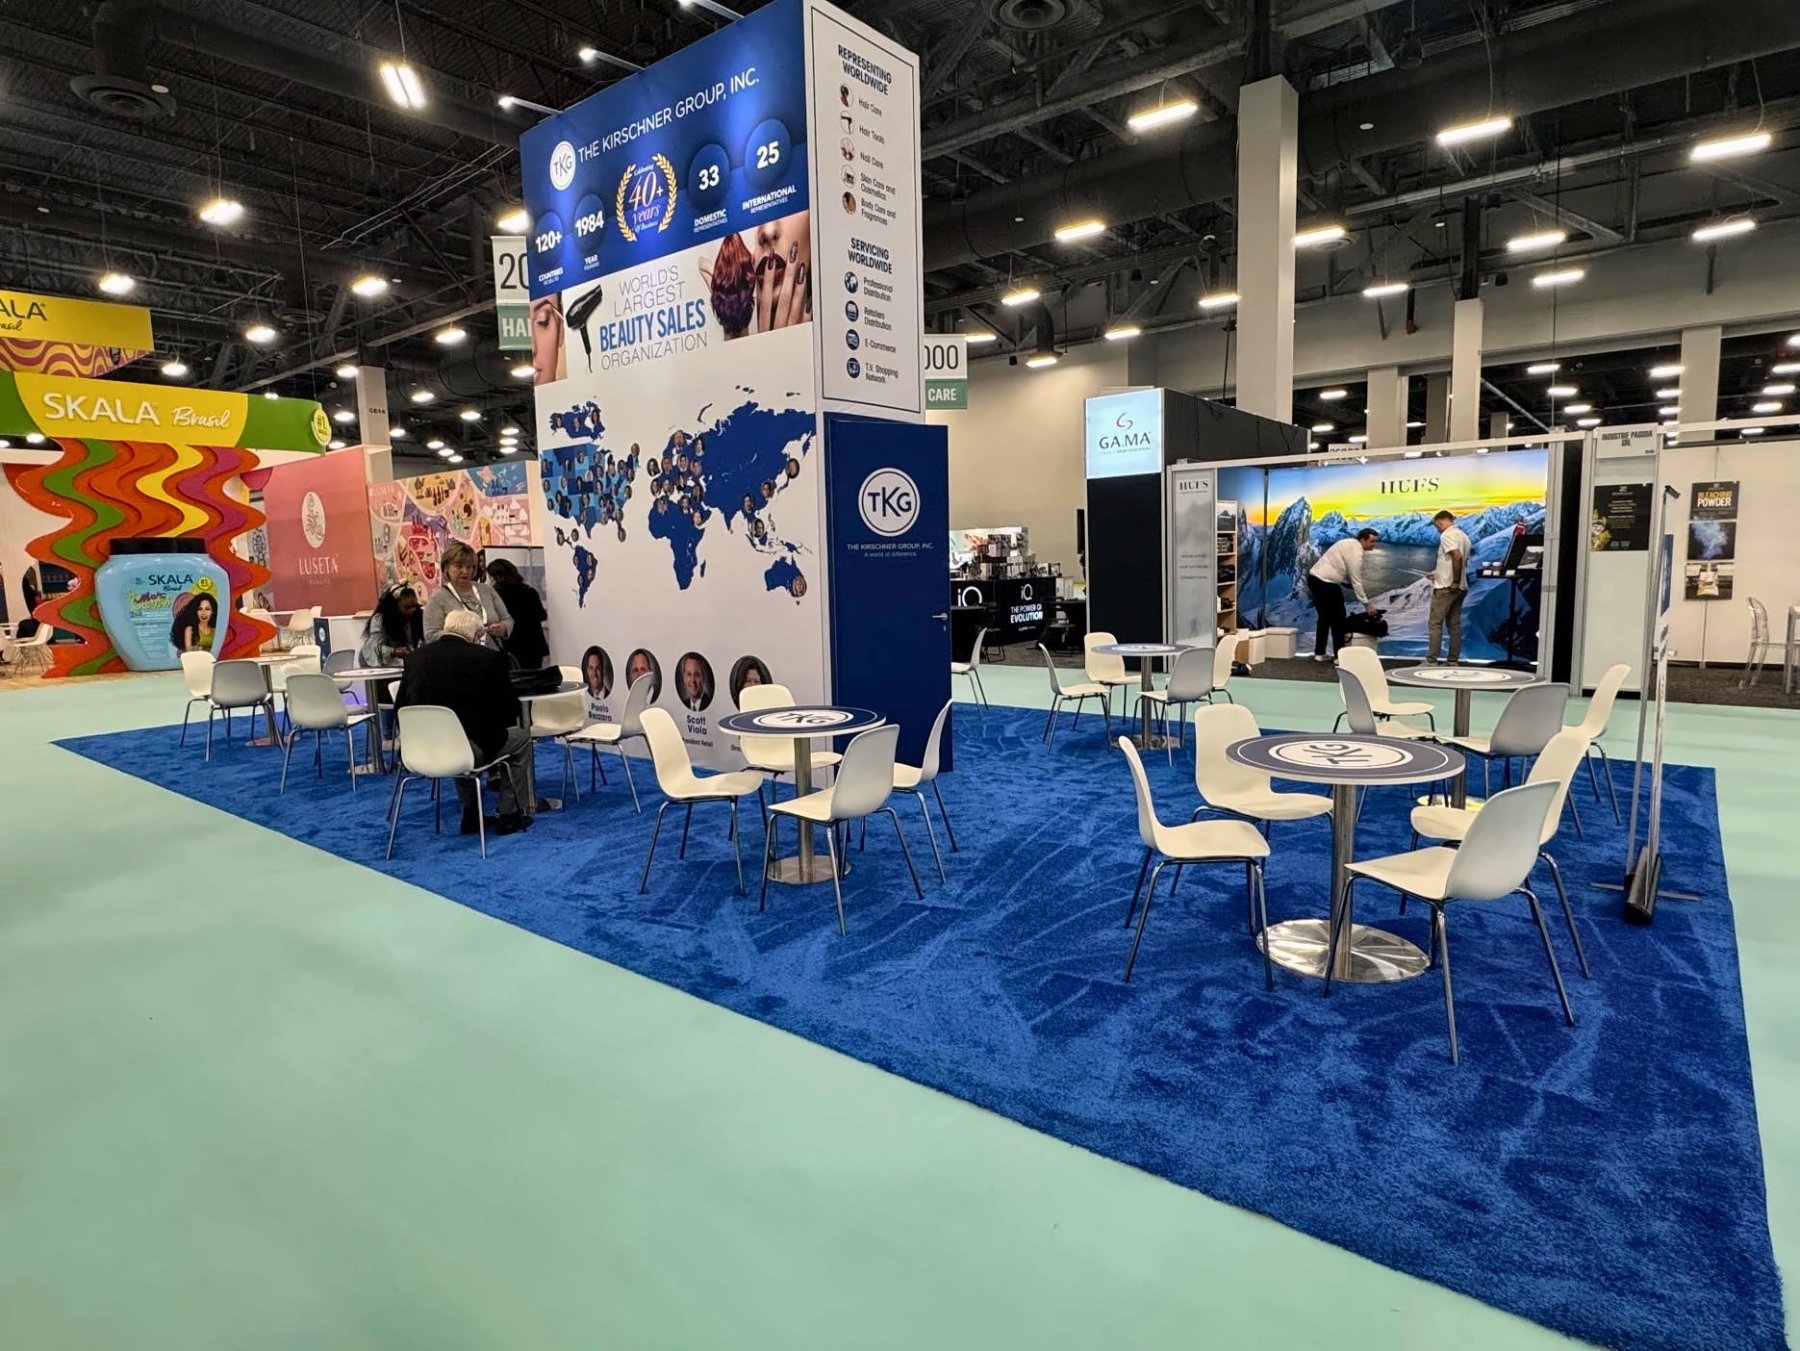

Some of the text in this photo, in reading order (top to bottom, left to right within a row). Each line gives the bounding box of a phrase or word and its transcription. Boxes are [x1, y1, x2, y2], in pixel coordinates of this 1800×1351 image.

[838, 44, 892, 84] REPRESENTING
[842, 60, 888, 95] WORLDWIDE
[578, 68, 759, 164] THE KIRSCHNER GROUP, INC.
[553, 152, 573, 179] TKG
[757, 141, 780, 169] 25
[628, 171, 664, 211] 40+
[698, 165, 720, 191] 33
[742, 184, 797, 210] INTERNATIONAL
[575, 210, 604, 238] 1984
[632, 204, 661, 231] years
[694, 208, 727, 227] DOMESTIC
[535, 230, 562, 253] 120+
[851, 237, 889, 260] SERVICING
[848, 249, 892, 274] WORLDWIDE
[618, 265, 679, 297] WORLD'S
[614, 281, 685, 318] LARGEST
[600, 298, 706, 352] BEAUTY SALES
[600, 331, 708, 371] ORGANIZATION
[928, 388, 957, 401] CARE
[43, 392, 230, 429] SKALA Brasil
[867, 486, 912, 518] TKG
[1697, 497, 1732, 507] POWDER
[299, 556, 338, 576] LUSETA
[148, 574, 194, 586] SKALA
[1010, 605, 1019, 614] THE
[1020, 603, 1036, 612] POWER
[1010, 611, 1043, 624] EVOLUTION
[686, 714, 706, 726] Scott
[688, 725, 707, 735] Viola
